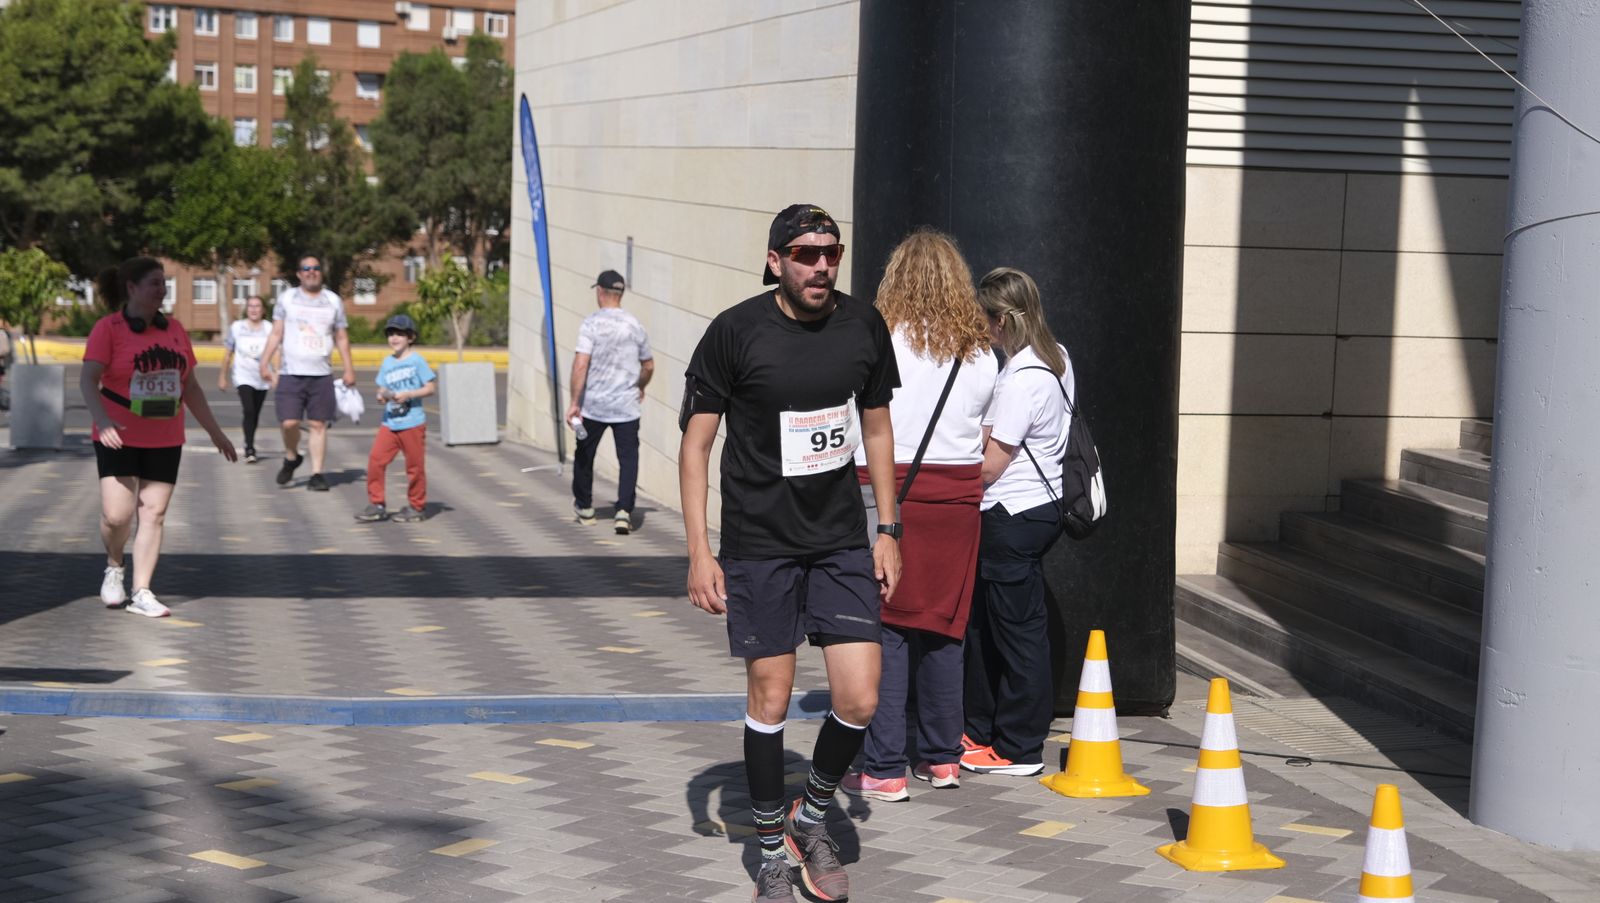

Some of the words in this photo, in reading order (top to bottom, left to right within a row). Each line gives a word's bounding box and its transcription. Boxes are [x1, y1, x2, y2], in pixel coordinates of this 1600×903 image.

[137, 380, 176, 393] 1013
[811, 427, 845, 452] 95
[802, 452, 828, 461] ANTONIO
